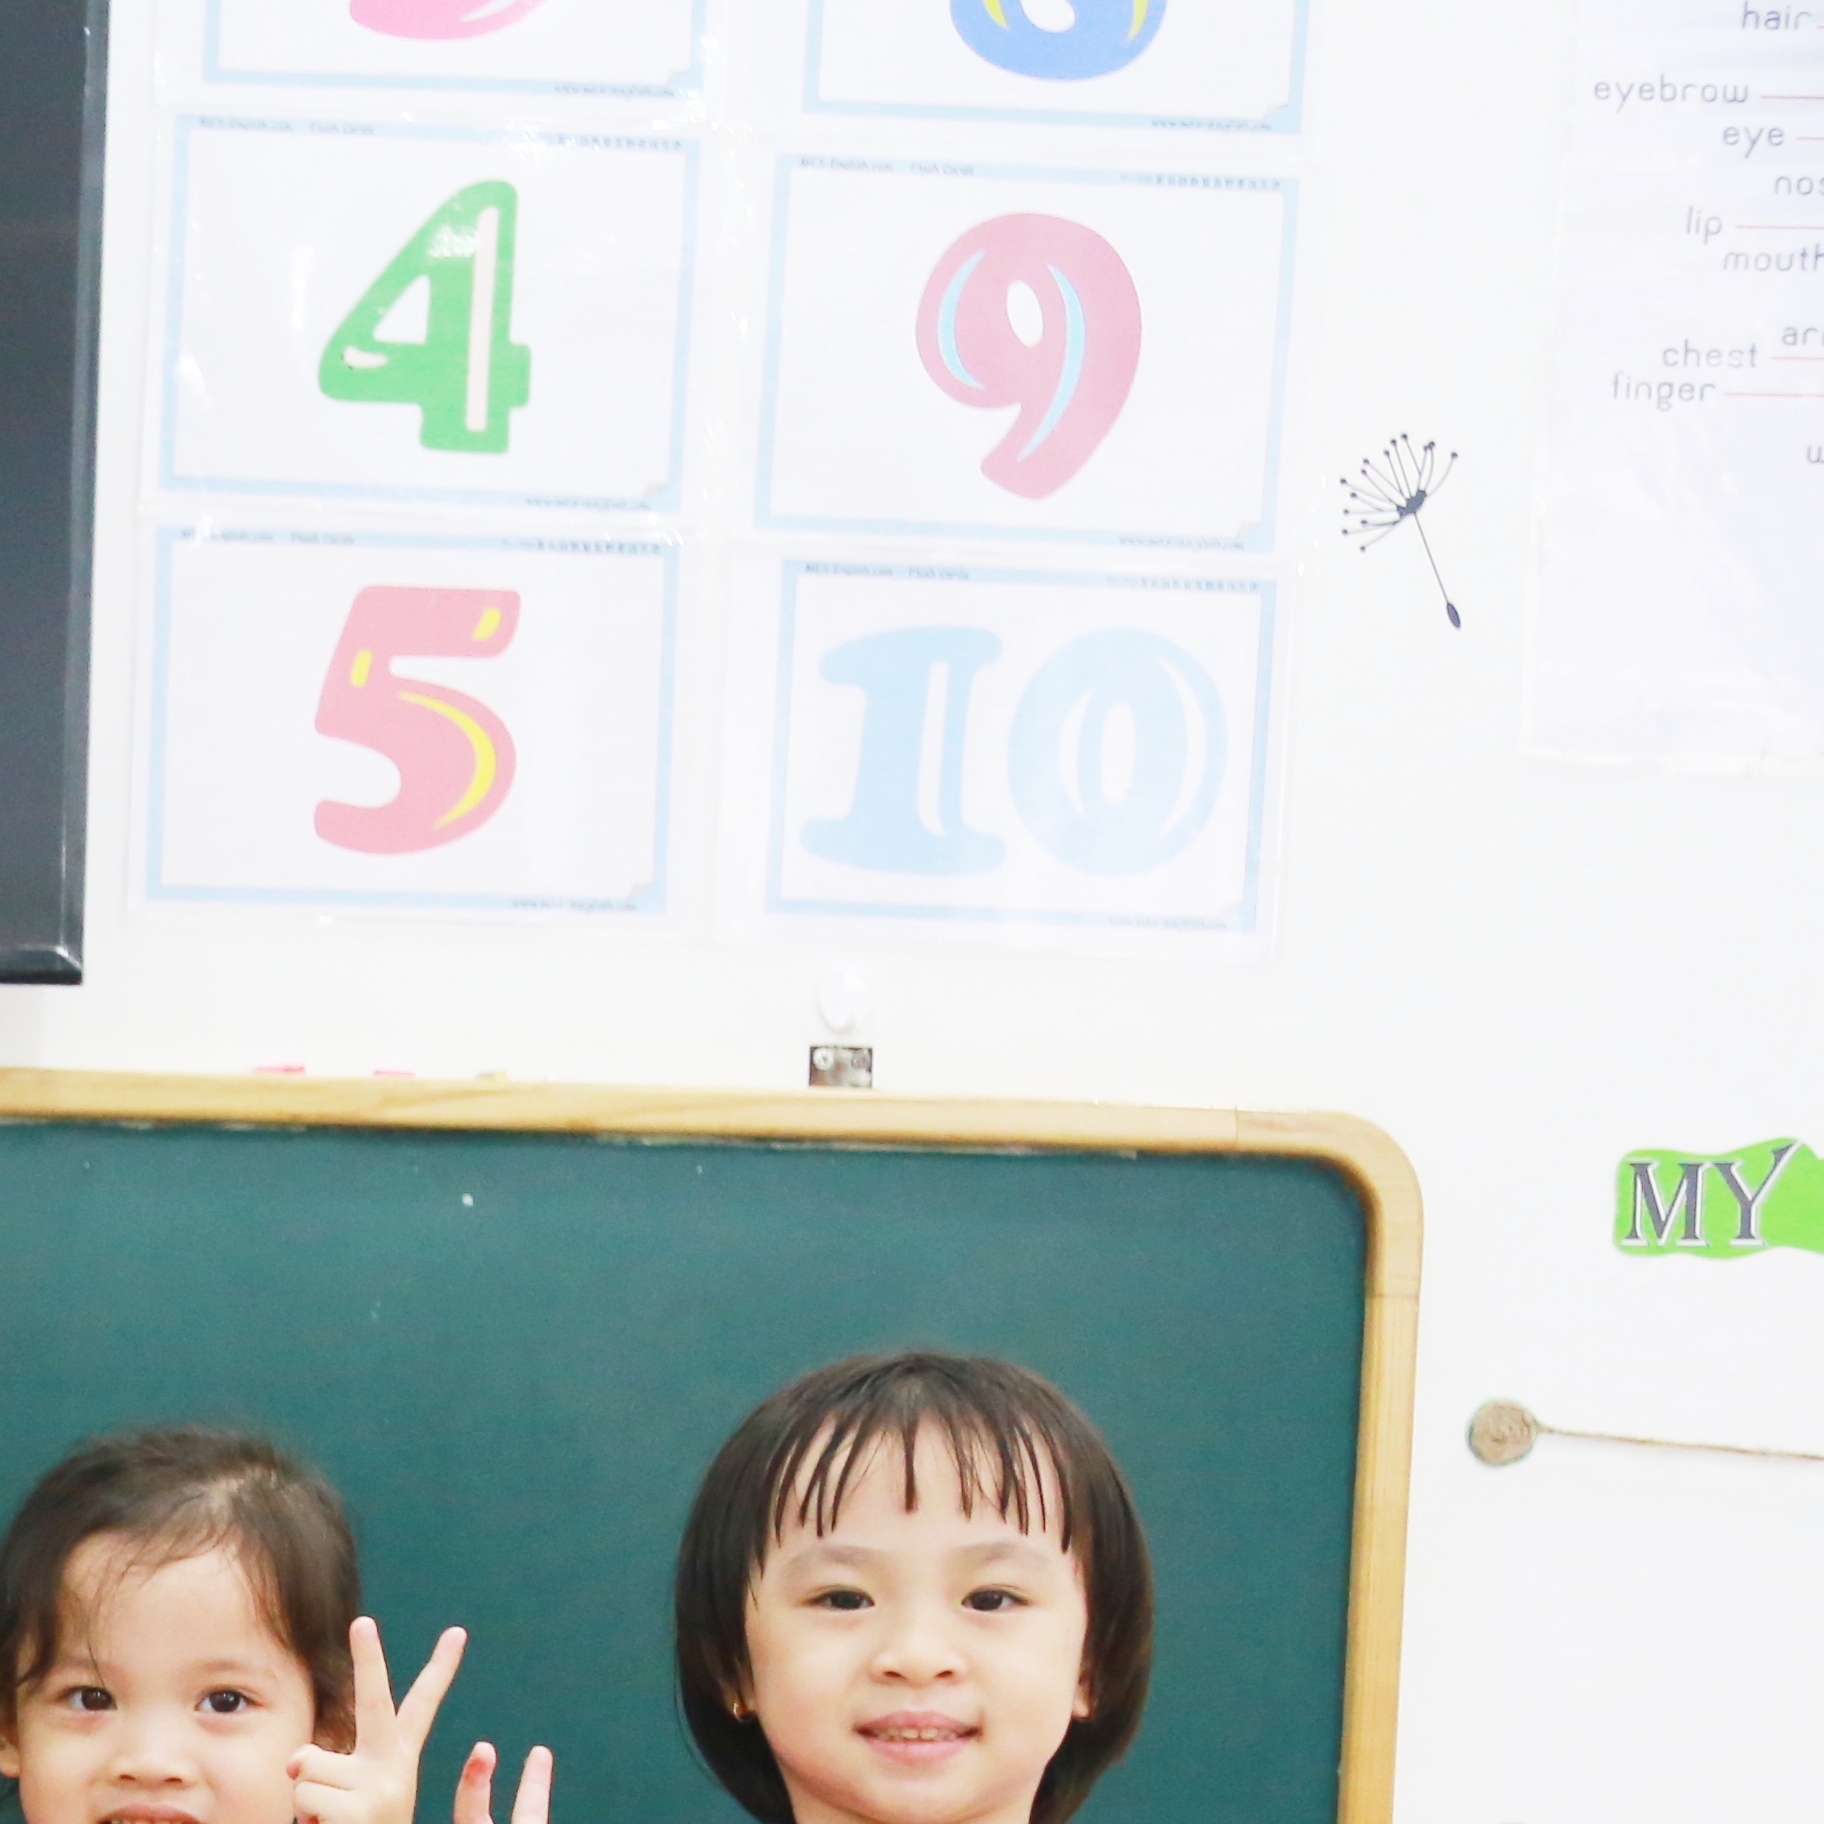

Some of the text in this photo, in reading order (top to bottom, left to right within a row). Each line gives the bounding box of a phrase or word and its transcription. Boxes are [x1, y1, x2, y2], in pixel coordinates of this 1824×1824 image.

[1741, 1, 1812, 30] hair
[1594, 74, 1750, 112] eyebrow
[1722, 126, 1785, 158] eye
[1686, 207, 1722, 244] lip
[318, 180, 532, 455] 4
[915, 212, 1142, 500] 9
[1662, 340, 1758, 368] chest
[1613, 371, 1716, 411] finger
[313, 584, 521, 856] 5
[799, 624, 1228, 878] 10
[1622, 1139, 1802, 1248] MY
